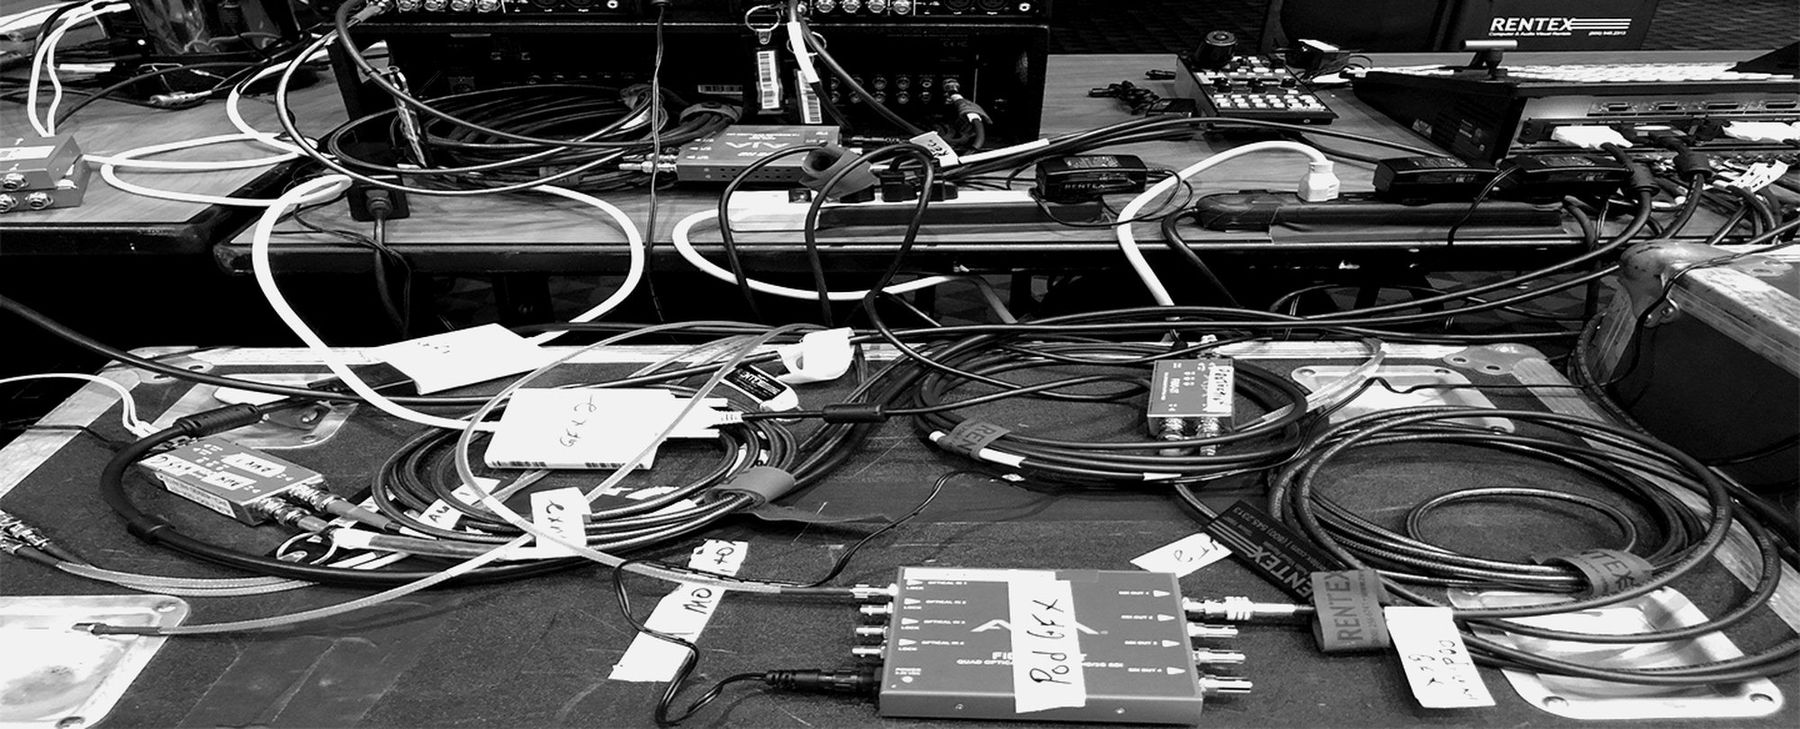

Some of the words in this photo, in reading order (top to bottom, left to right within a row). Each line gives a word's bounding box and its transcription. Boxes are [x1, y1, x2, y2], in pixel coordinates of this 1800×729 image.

[1490, 17, 1573, 31] RENTEX
[1247, 546, 1314, 604] ENTEX
[1325, 571, 1363, 642] RENTEX
[1029, 650, 1073, 685] Pod
